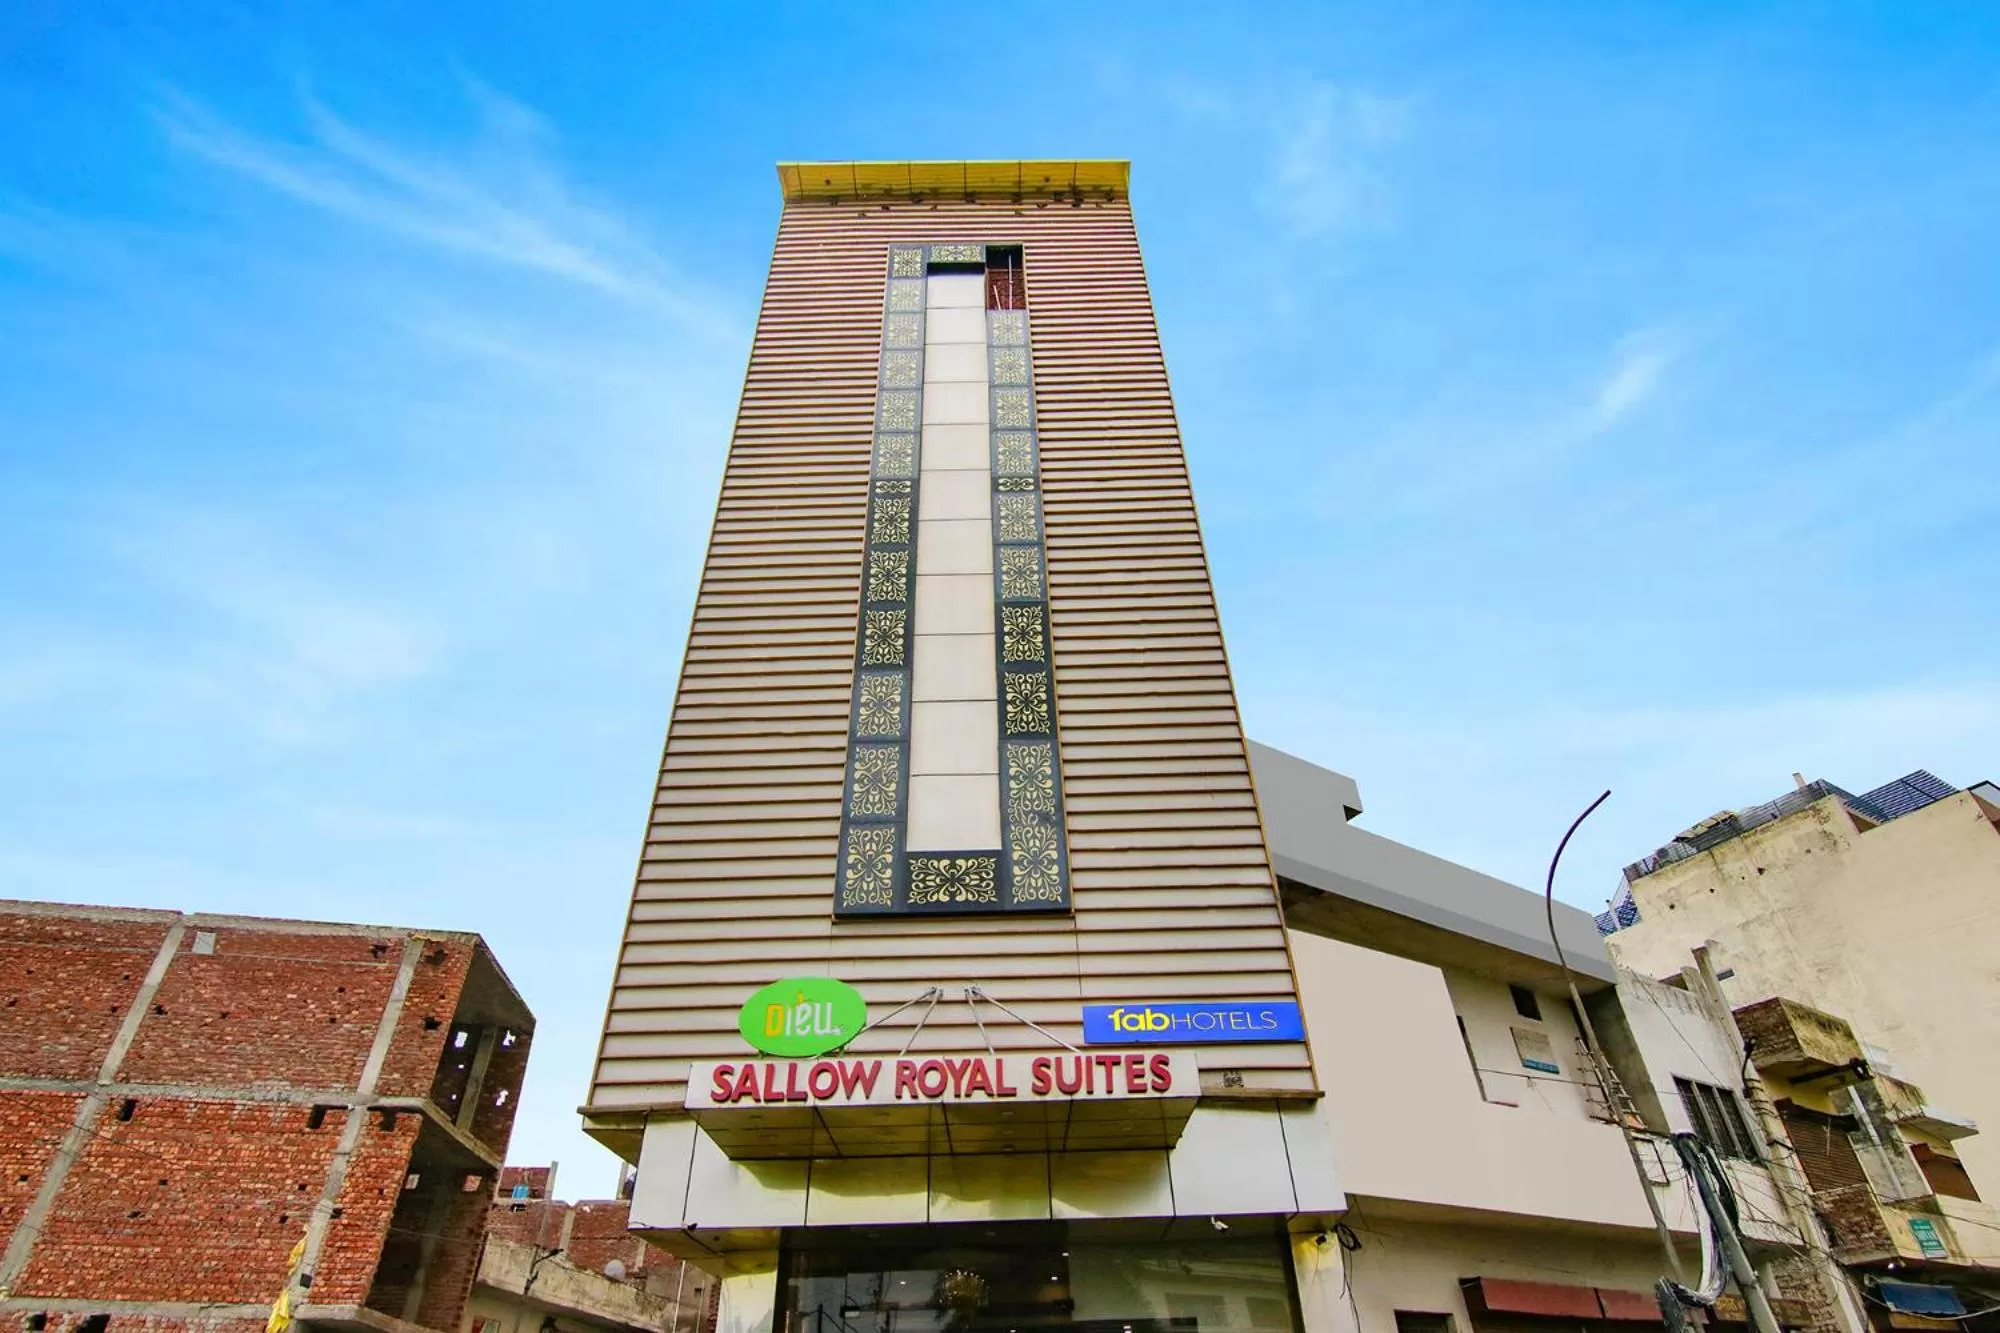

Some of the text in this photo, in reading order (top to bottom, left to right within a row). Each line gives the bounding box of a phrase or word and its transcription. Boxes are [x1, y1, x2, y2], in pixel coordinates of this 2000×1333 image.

[710, 1054, 1173, 1103] SALLOW ROYAL SUITES
